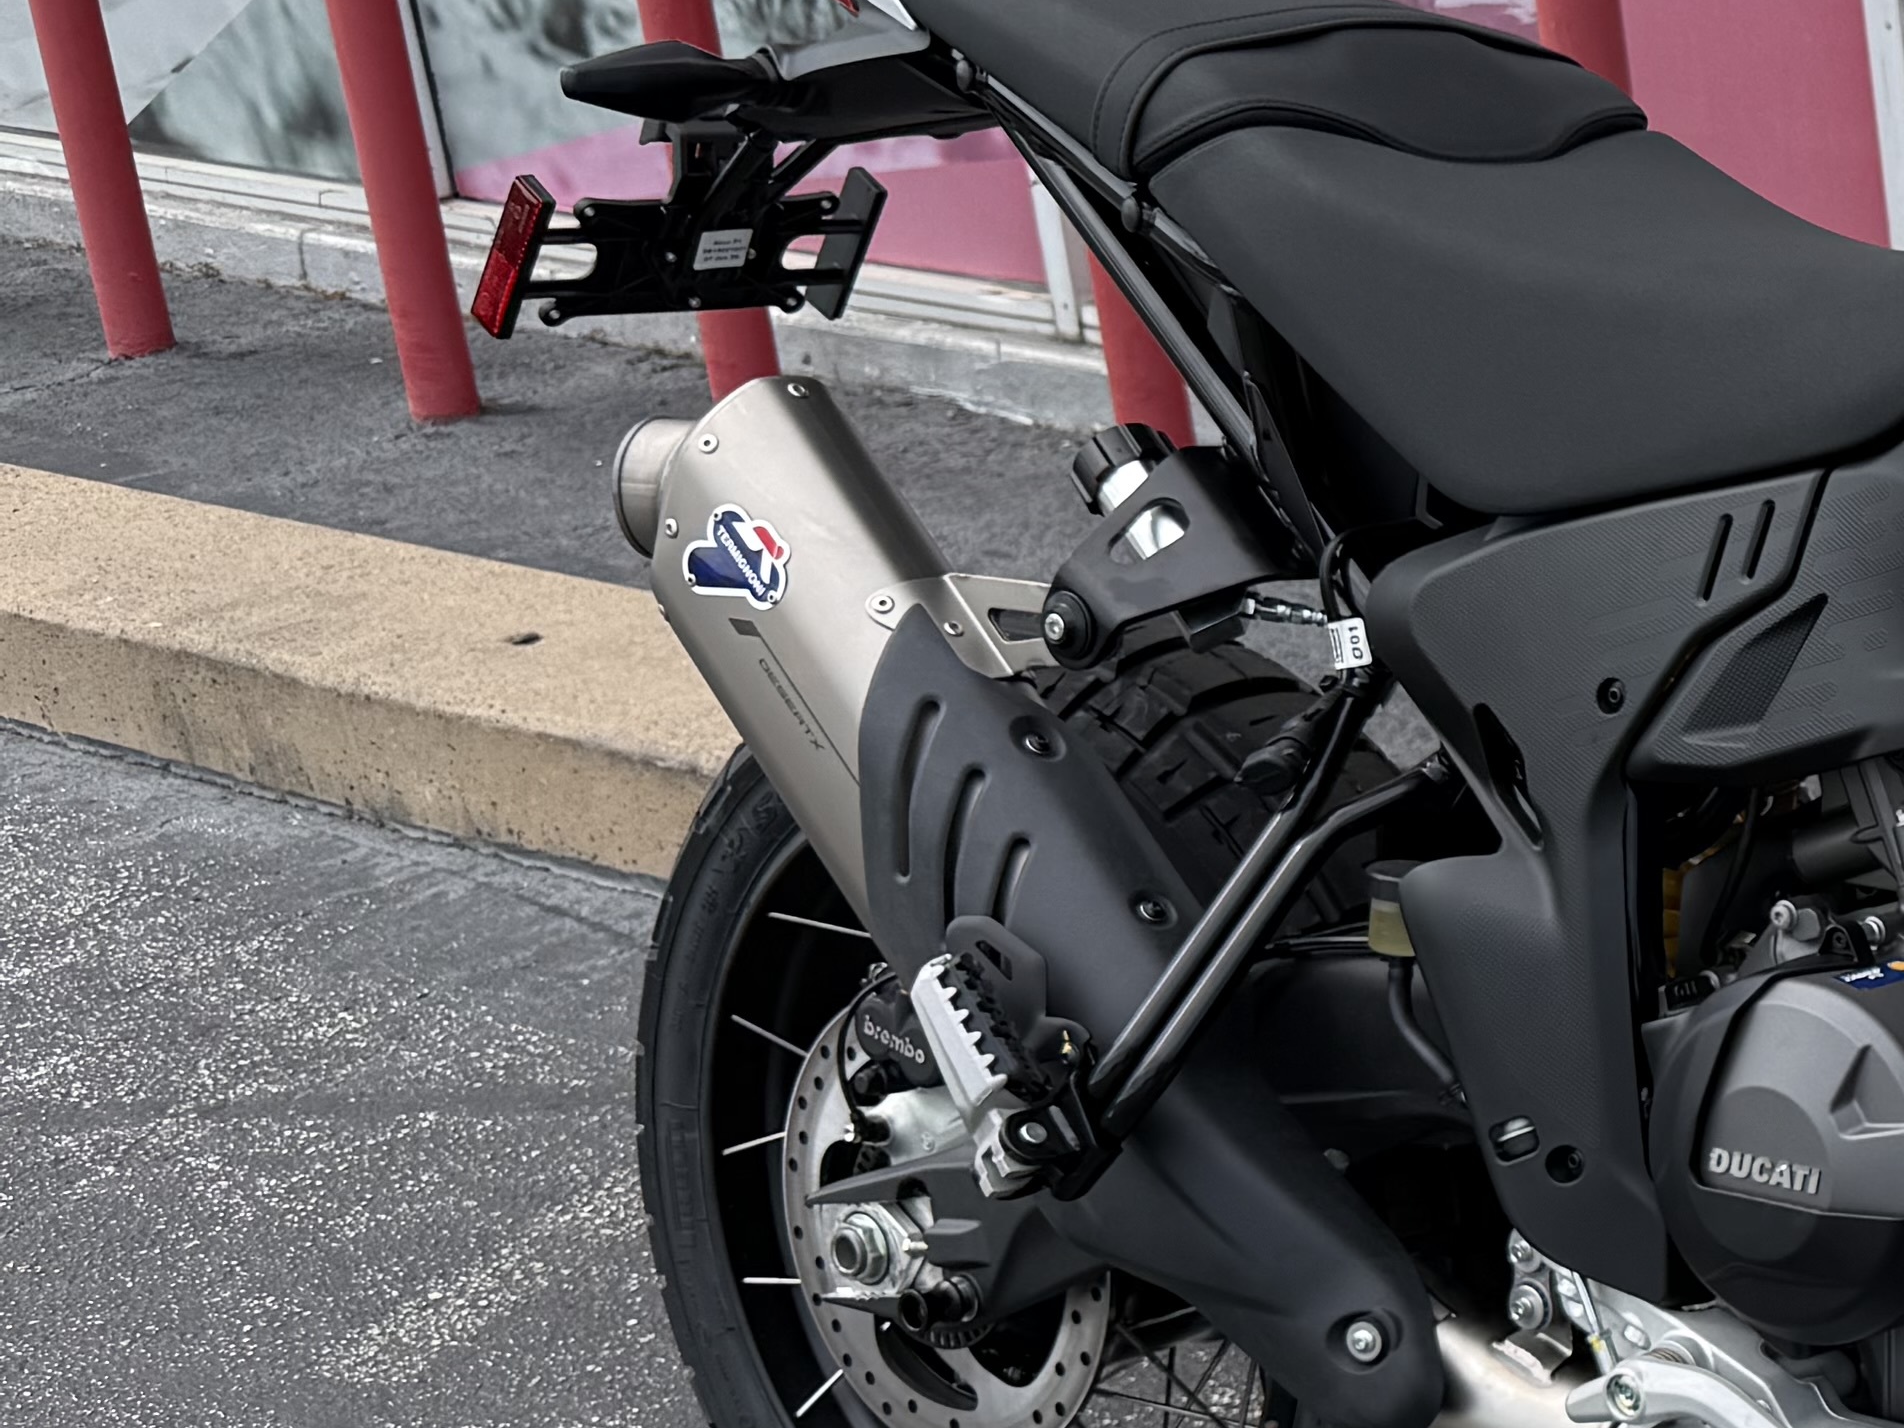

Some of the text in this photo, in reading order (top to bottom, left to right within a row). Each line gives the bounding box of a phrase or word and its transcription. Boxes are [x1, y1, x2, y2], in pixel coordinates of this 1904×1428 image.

[717, 524, 765, 598] TERMIGNONI
[864, 1014, 926, 1064] brembo
[1709, 1147, 1821, 1194] DUCATI
